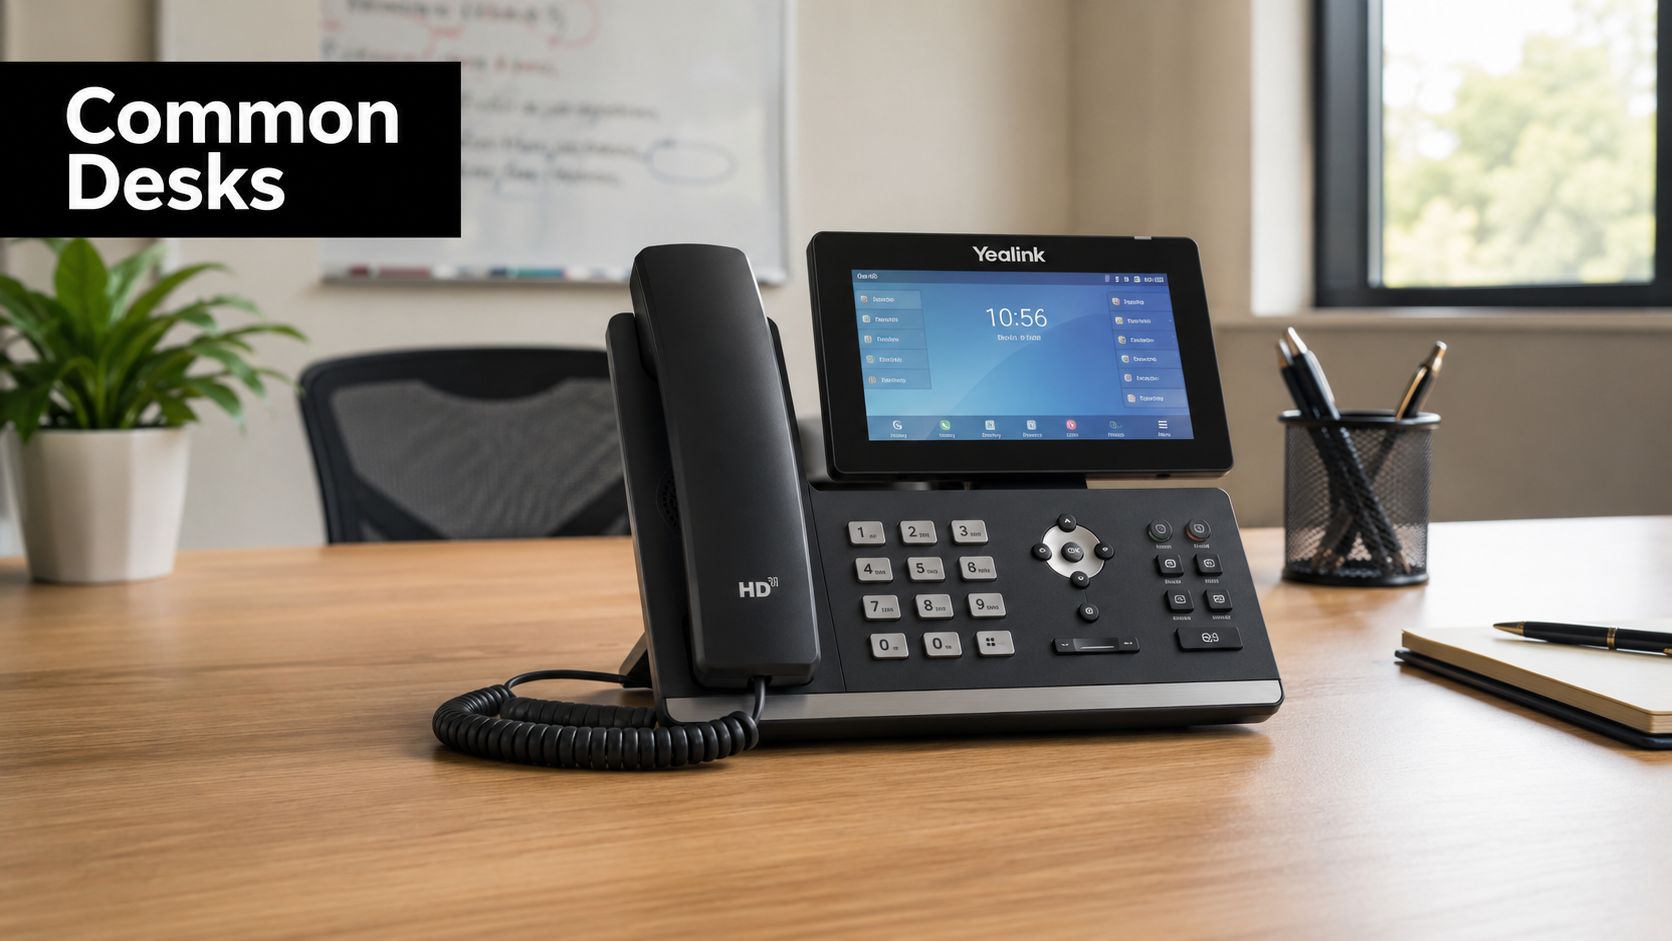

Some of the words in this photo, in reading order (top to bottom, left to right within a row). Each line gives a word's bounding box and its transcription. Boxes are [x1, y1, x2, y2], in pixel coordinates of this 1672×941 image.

[972, 246, 1046, 263] Yealink
[986, 307, 1048, 327] 10:56
[858, 526, 865, 538] 1
[908, 526, 917, 537] 2
[959, 525, 968, 537] 3
[863, 563, 873, 574] 4
[916, 562, 925, 574] 5
[967, 562, 977, 573] 6
[738, 581, 771, 598] HD
[870, 600, 879, 612] 7
[923, 600, 933, 611] 8
[975, 598, 985, 610] 9
[879, 639, 889, 651] 0
[932, 637, 942, 649] 0
